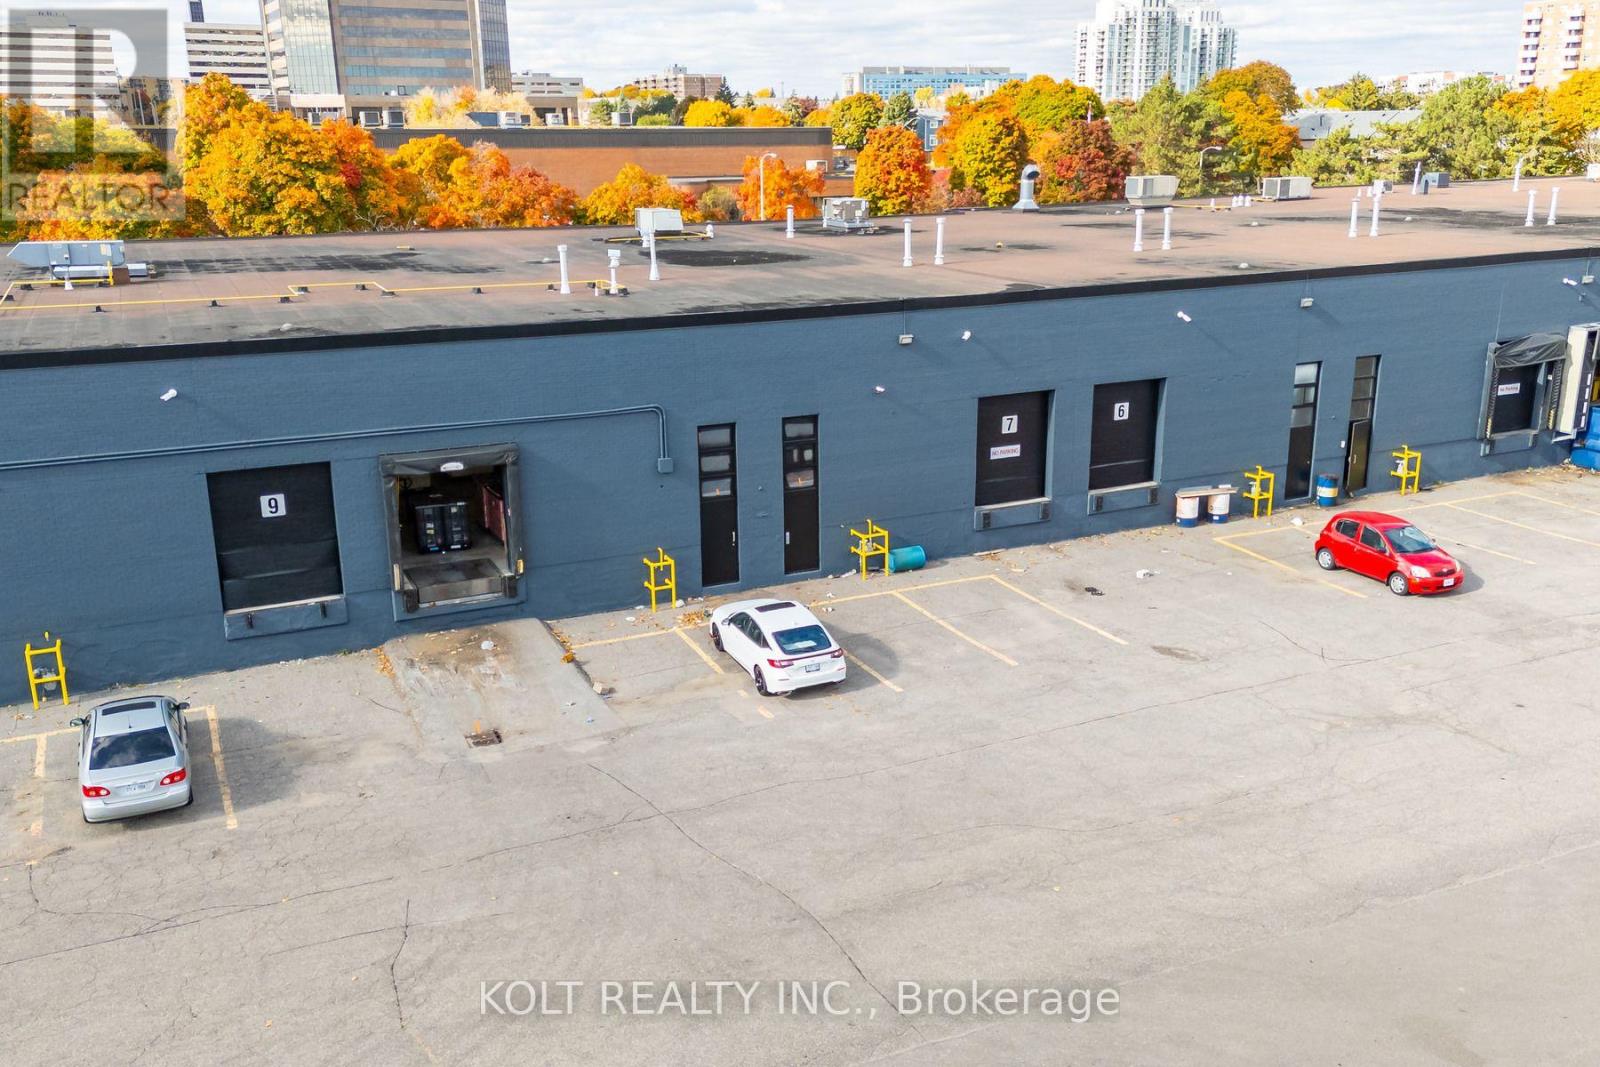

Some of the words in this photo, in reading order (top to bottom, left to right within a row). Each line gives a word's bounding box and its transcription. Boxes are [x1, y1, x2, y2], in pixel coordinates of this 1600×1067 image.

[1118, 405, 1125, 417] 6
[1006, 418, 1014, 431] 7
[268, 497, 279, 514] 9
